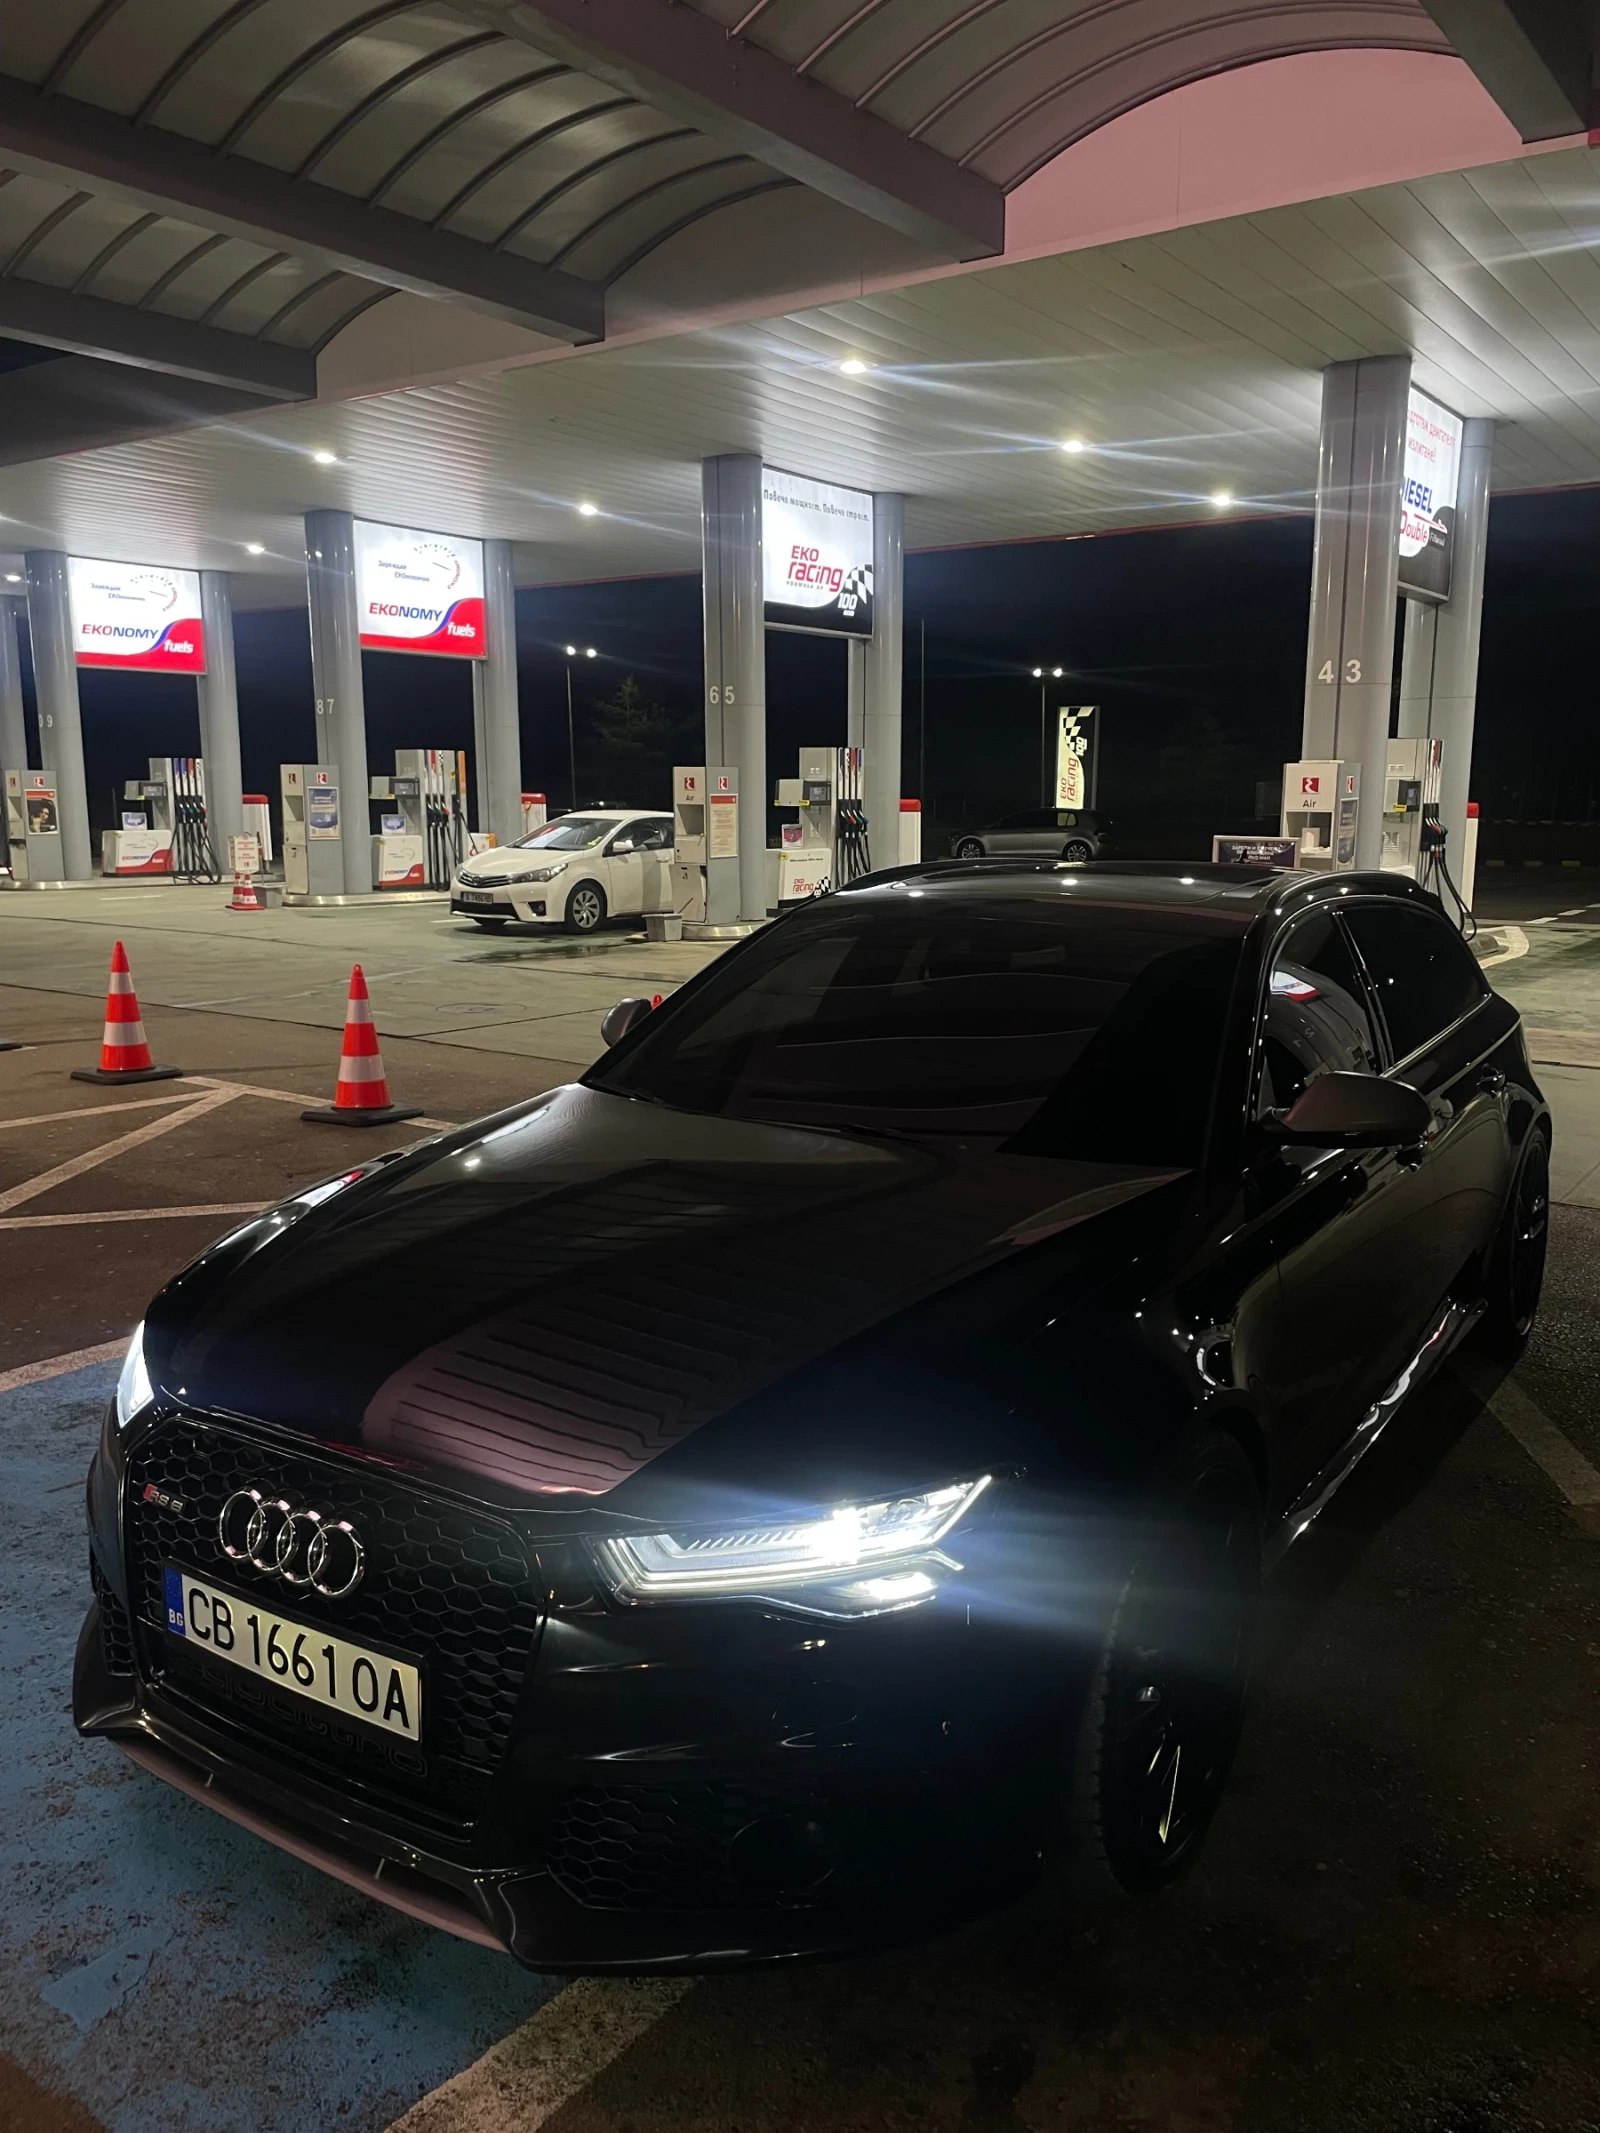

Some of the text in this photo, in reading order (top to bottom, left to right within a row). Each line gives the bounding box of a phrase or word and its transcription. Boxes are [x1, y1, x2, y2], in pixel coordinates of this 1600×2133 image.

[763, 489, 789, 504] Повече
[823, 503, 845, 517] Повече
[1402, 477, 1432, 514] IESEL
[1400, 510, 1427, 543] Double
[791, 545, 819, 562] EKO
[788, 561, 844, 593] racing
[837, 592, 858, 610] 100
[369, 602, 443, 621] EKONOMY
[82, 624, 159, 639] EKONOMY
[447, 621, 475, 637] fuels
[163, 639, 194, 654] fuels
[1317, 659, 1361, 684] 4 3
[709, 685, 735, 705] 6 5
[317, 698, 335, 715] 8 7
[46, 714, 53, 728] 9
[1060, 777, 1068, 800] EKO
[1067, 757, 1080, 802] racing
[685, 794, 694, 802] Air
[1302, 799, 1316, 808] Air
[792, 883, 814, 893] racing
[168, 1608, 184, 1627] BG
[188, 1587, 410, 1730] CB 1661 OA
